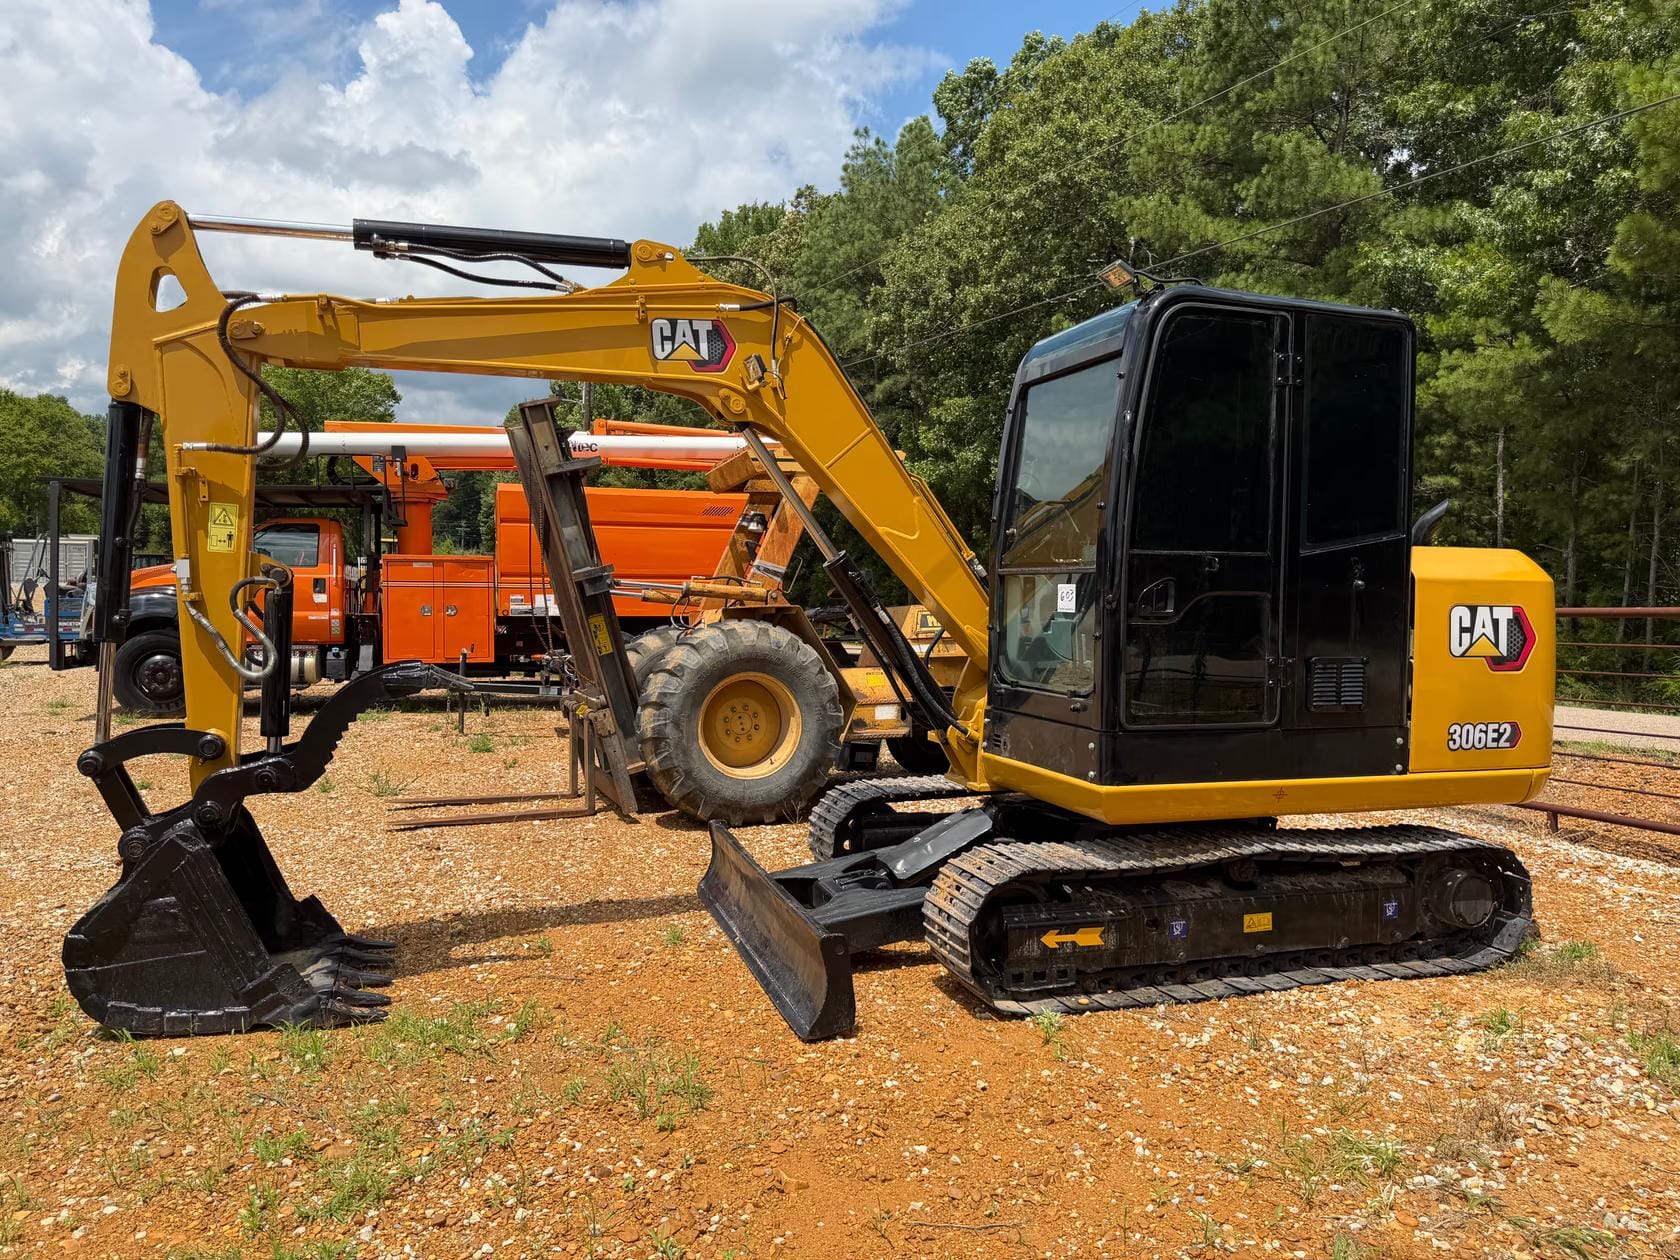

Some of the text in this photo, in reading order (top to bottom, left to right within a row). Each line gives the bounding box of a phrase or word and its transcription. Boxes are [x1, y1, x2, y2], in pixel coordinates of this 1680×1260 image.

[652, 319, 712, 360] CAT
[1450, 605, 1513, 656] CAT
[1448, 723, 1512, 750] 306E2
